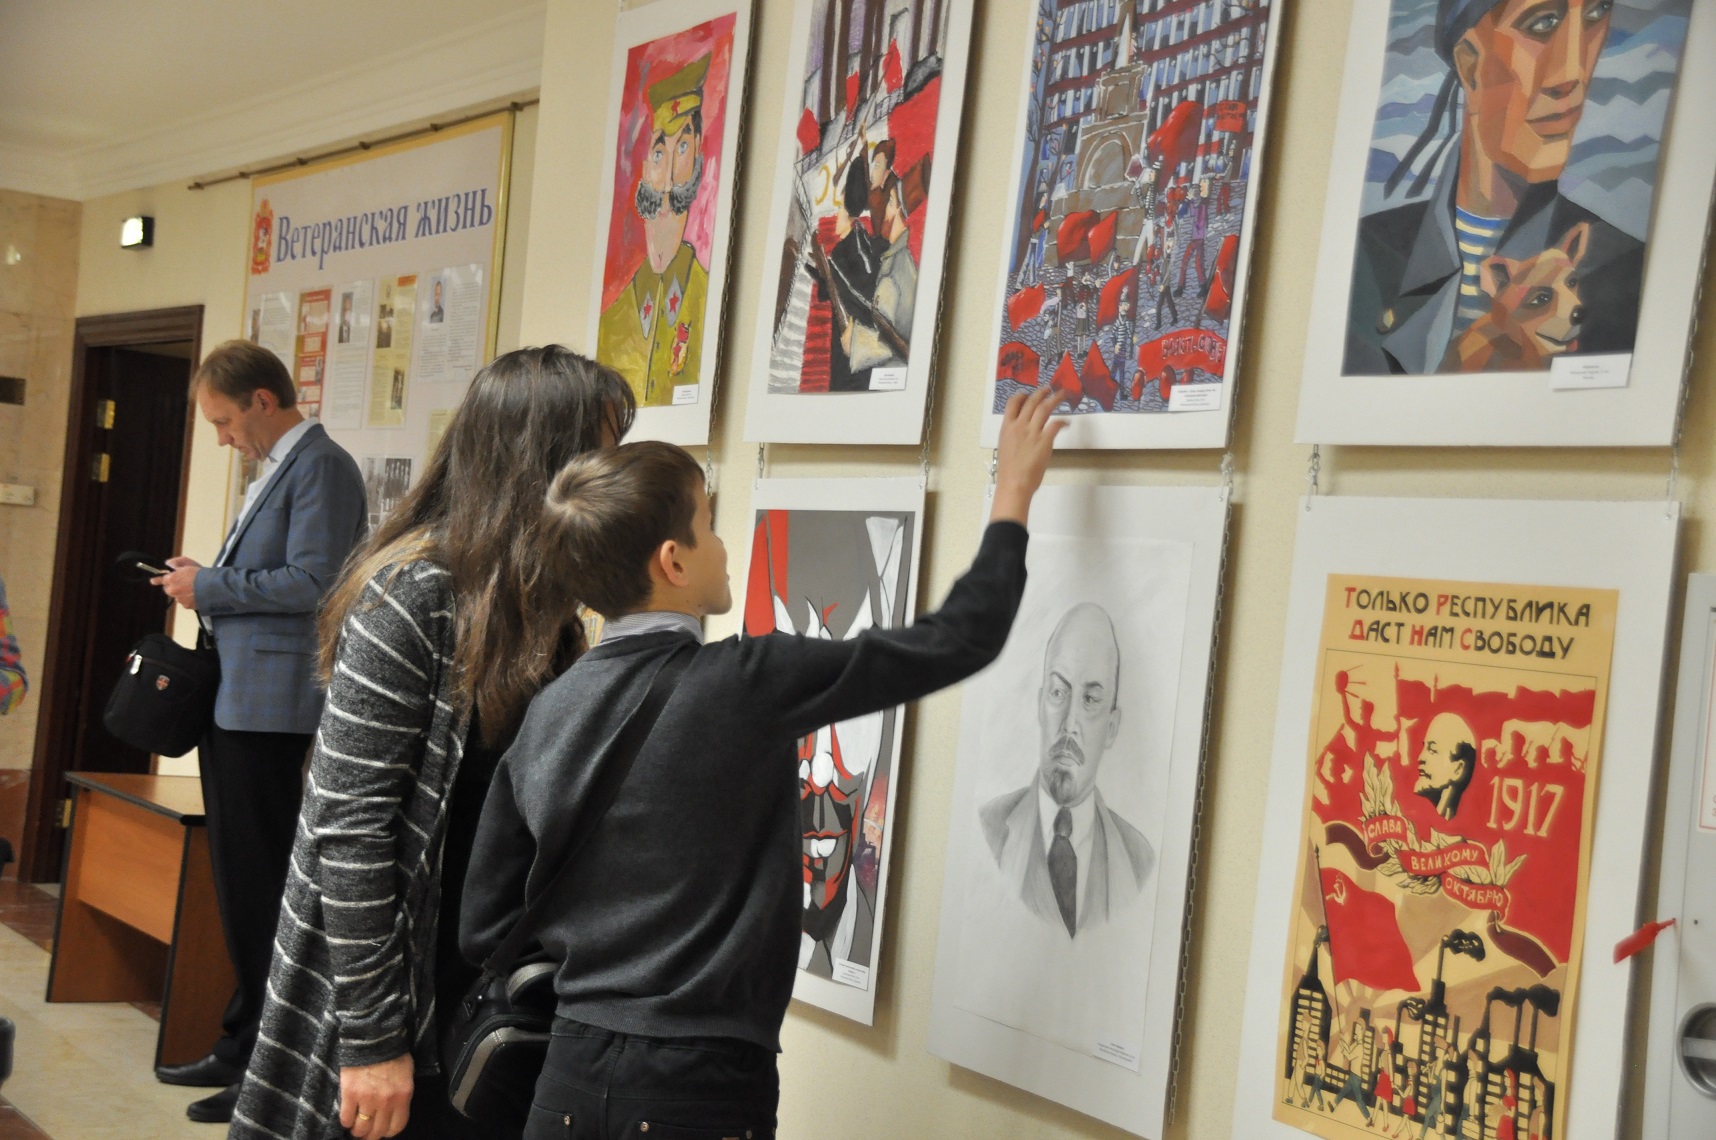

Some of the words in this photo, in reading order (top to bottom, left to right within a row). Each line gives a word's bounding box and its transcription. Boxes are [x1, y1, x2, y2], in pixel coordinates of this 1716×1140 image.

[275, 205, 409, 270] Ветеранская
[414, 188, 493, 238] жизнь
[1344, 587, 1429, 614] ТОЛЬКО
[1436, 594, 1591, 627] РЕСПУБЛИКА
[1348, 619, 1405, 645] ДАСТ
[1409, 624, 1455, 650] НАМ
[1459, 627, 1575, 660] СВОБОДУ
[1486, 775, 1564, 837] 1917
[1367, 819, 1402, 838] СЛАВА
[1410, 847, 1479, 871] ВЕЛИКОМУ
[1445, 877, 1504, 907] ОКТЯБРЮ
